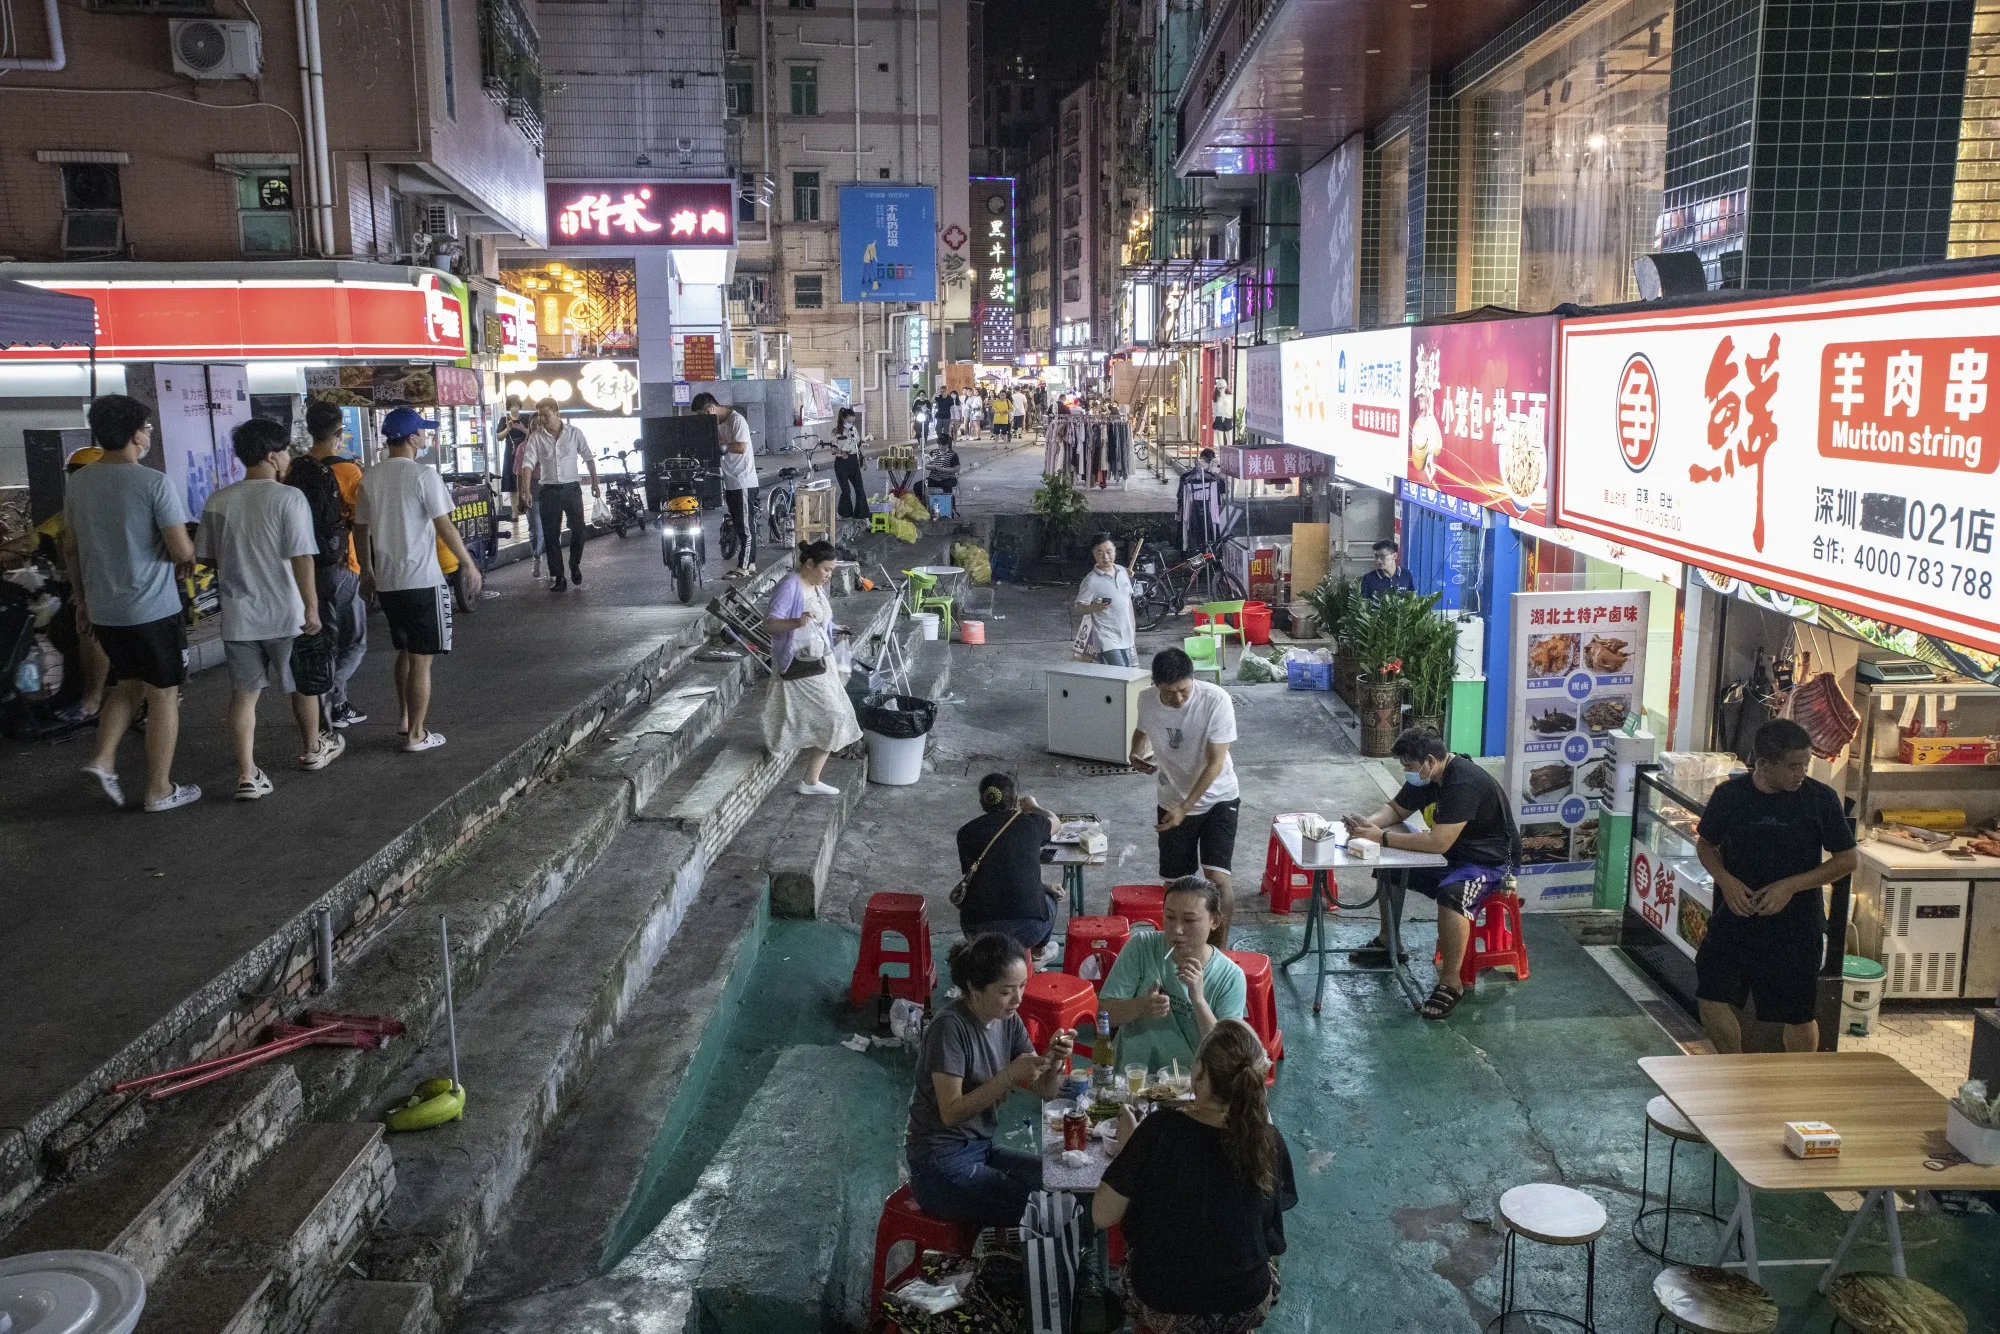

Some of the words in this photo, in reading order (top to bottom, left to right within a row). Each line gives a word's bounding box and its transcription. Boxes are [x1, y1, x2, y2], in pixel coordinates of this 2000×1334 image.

[886, 204, 899, 248] 不乱扔垃圾
[989, 220, 1006, 300] 黑牛码头
[588, 367, 638, 409] 食神
[1830, 348, 1989, 421] 羊肉串
[1619, 367, 1656, 459] 争
[1247, 454, 1276, 476] 辣鱼
[1282, 452, 1325, 474] 酱板鸭
[1832, 420, 1905, 453] Mutton
[1908, 425, 1982, 468] string
[1854, 544, 1901, 578] 4000
[1906, 554, 1945, 589] 783
[1950, 564, 1994, 600] 788
[1530, 605, 1638, 625] 湖北土特产卤味
[1571, 681, 1589, 691] 现卤
[1567, 745, 1585, 754] 味美
[1563, 806, 1584, 815] 土特产
